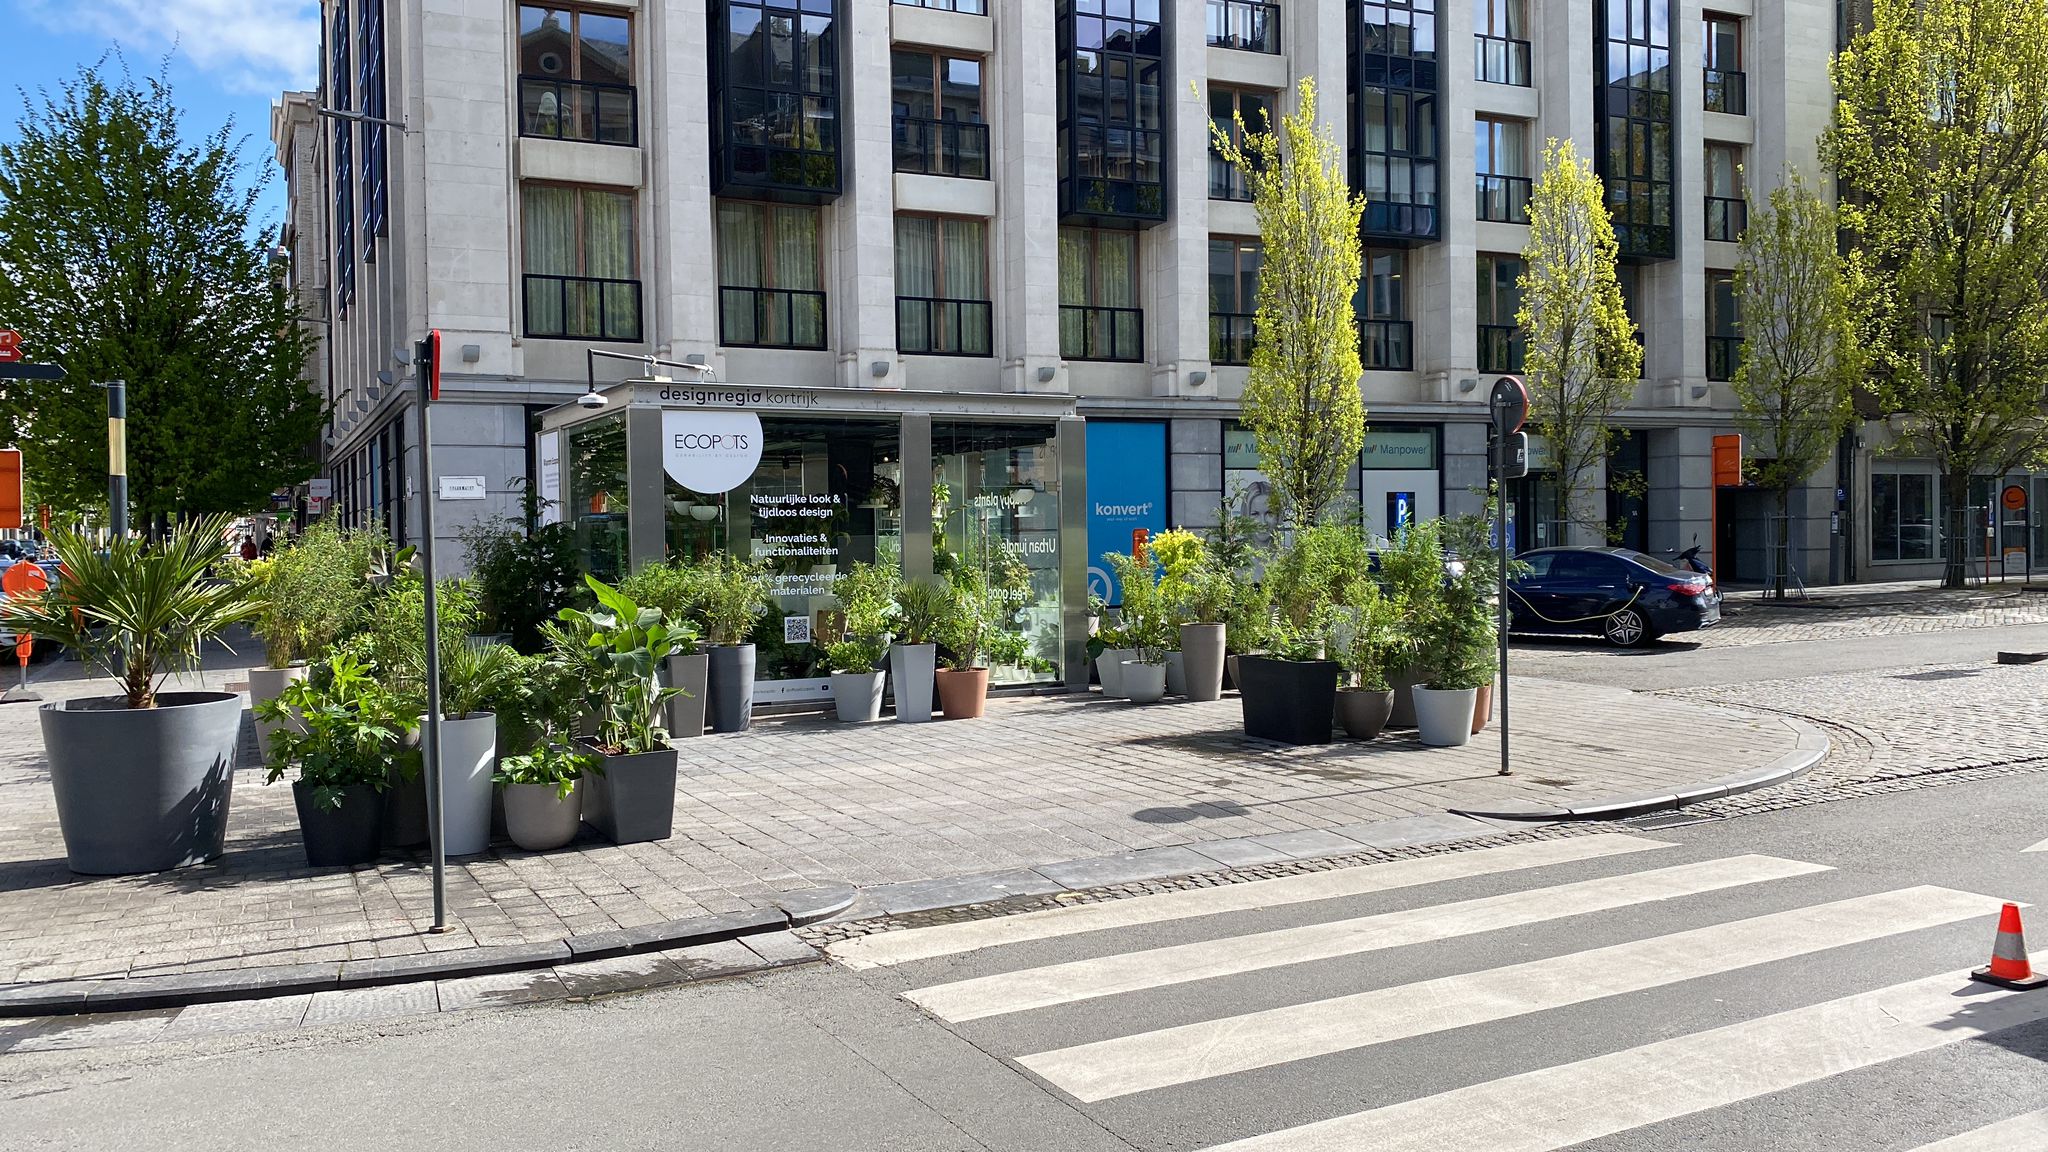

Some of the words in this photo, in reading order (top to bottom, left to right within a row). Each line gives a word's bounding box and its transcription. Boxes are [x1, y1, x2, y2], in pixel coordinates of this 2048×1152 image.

[660, 386, 761, 406] designregio
[766, 389, 818, 408] kortrijk
[674, 434, 748, 449] ECOPOTS
[1380, 444, 1427, 456] Manpower
[750, 494, 807, 505] Natuurlijke
[809, 494, 831, 504] look
[833, 494, 841, 504] &
[759, 507, 797, 518] tijdloos
[799, 507, 833, 518] design
[1095, 502, 1148, 516] konvert
[765, 533, 818, 543] Innovaties
[820, 533, 828, 543] &
[755, 545, 839, 556] functionaliteiten
[775, 571, 848, 585] gerecycleerde
[770, 585, 825, 596] materialen
